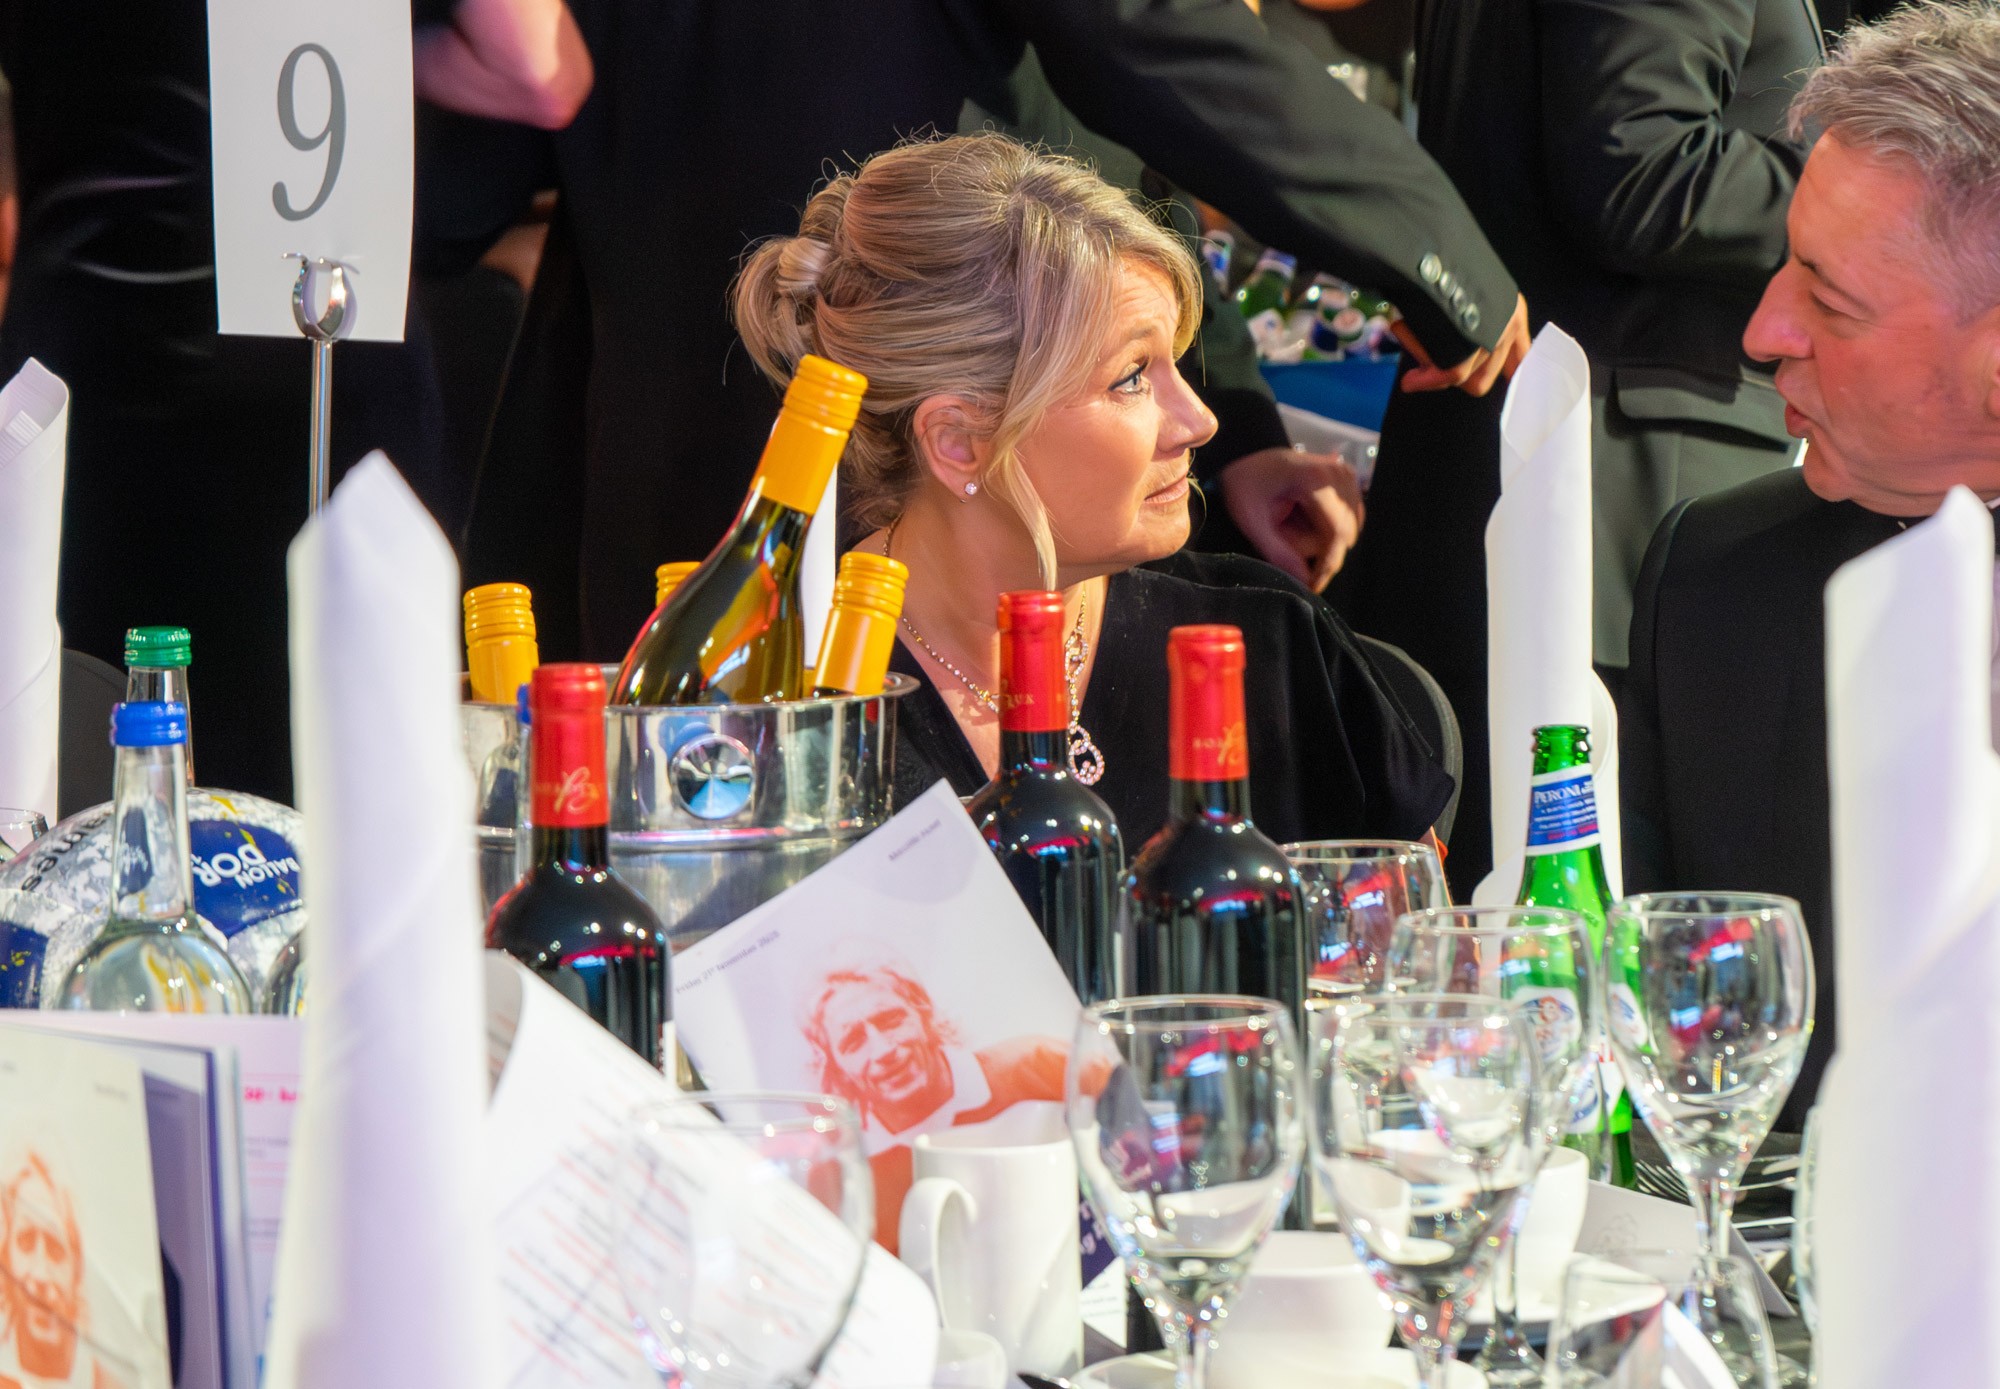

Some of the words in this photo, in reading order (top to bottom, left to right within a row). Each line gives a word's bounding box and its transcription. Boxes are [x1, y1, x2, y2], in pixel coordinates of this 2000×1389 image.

[272, 42, 347, 222] 9
[1534, 784, 1581, 805] PERONI
[234, 856, 300, 890] BALLON
